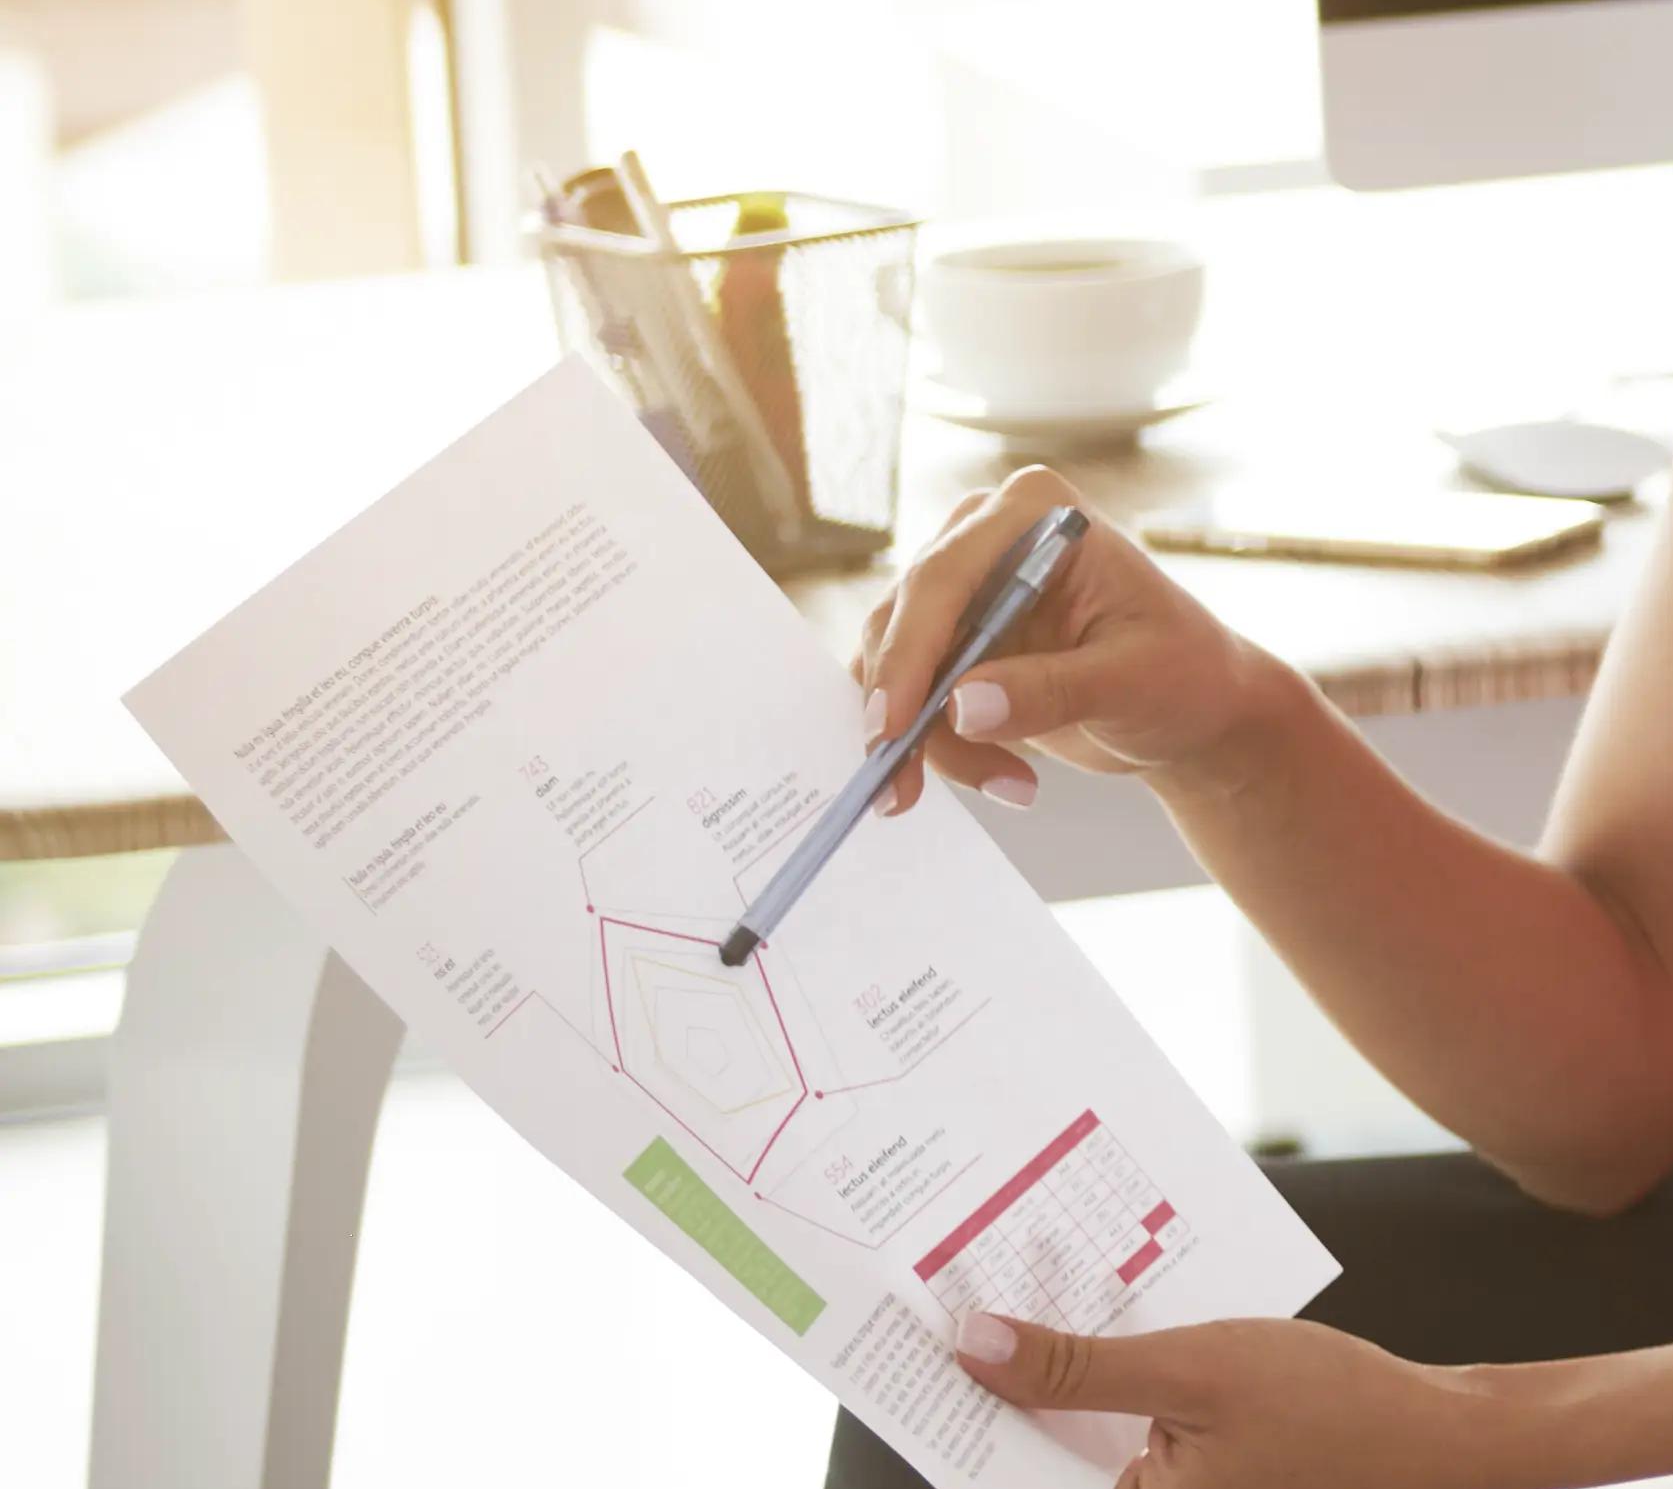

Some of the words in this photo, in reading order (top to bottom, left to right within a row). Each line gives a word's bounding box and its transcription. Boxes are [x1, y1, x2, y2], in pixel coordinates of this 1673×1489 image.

[516, 754, 550, 783] 743
[535, 776, 559, 798] diam
[686, 786, 718, 815] 821
[702, 788, 747, 829] dignissim
[852, 983, 887, 1015] 302
[866, 1001, 899, 1029] lectus
[898, 965, 937, 1003] eleifend
[824, 1154, 854, 1185] 554
[836, 1171, 869, 1199] lectus
[868, 1135, 908, 1174] eleifend
